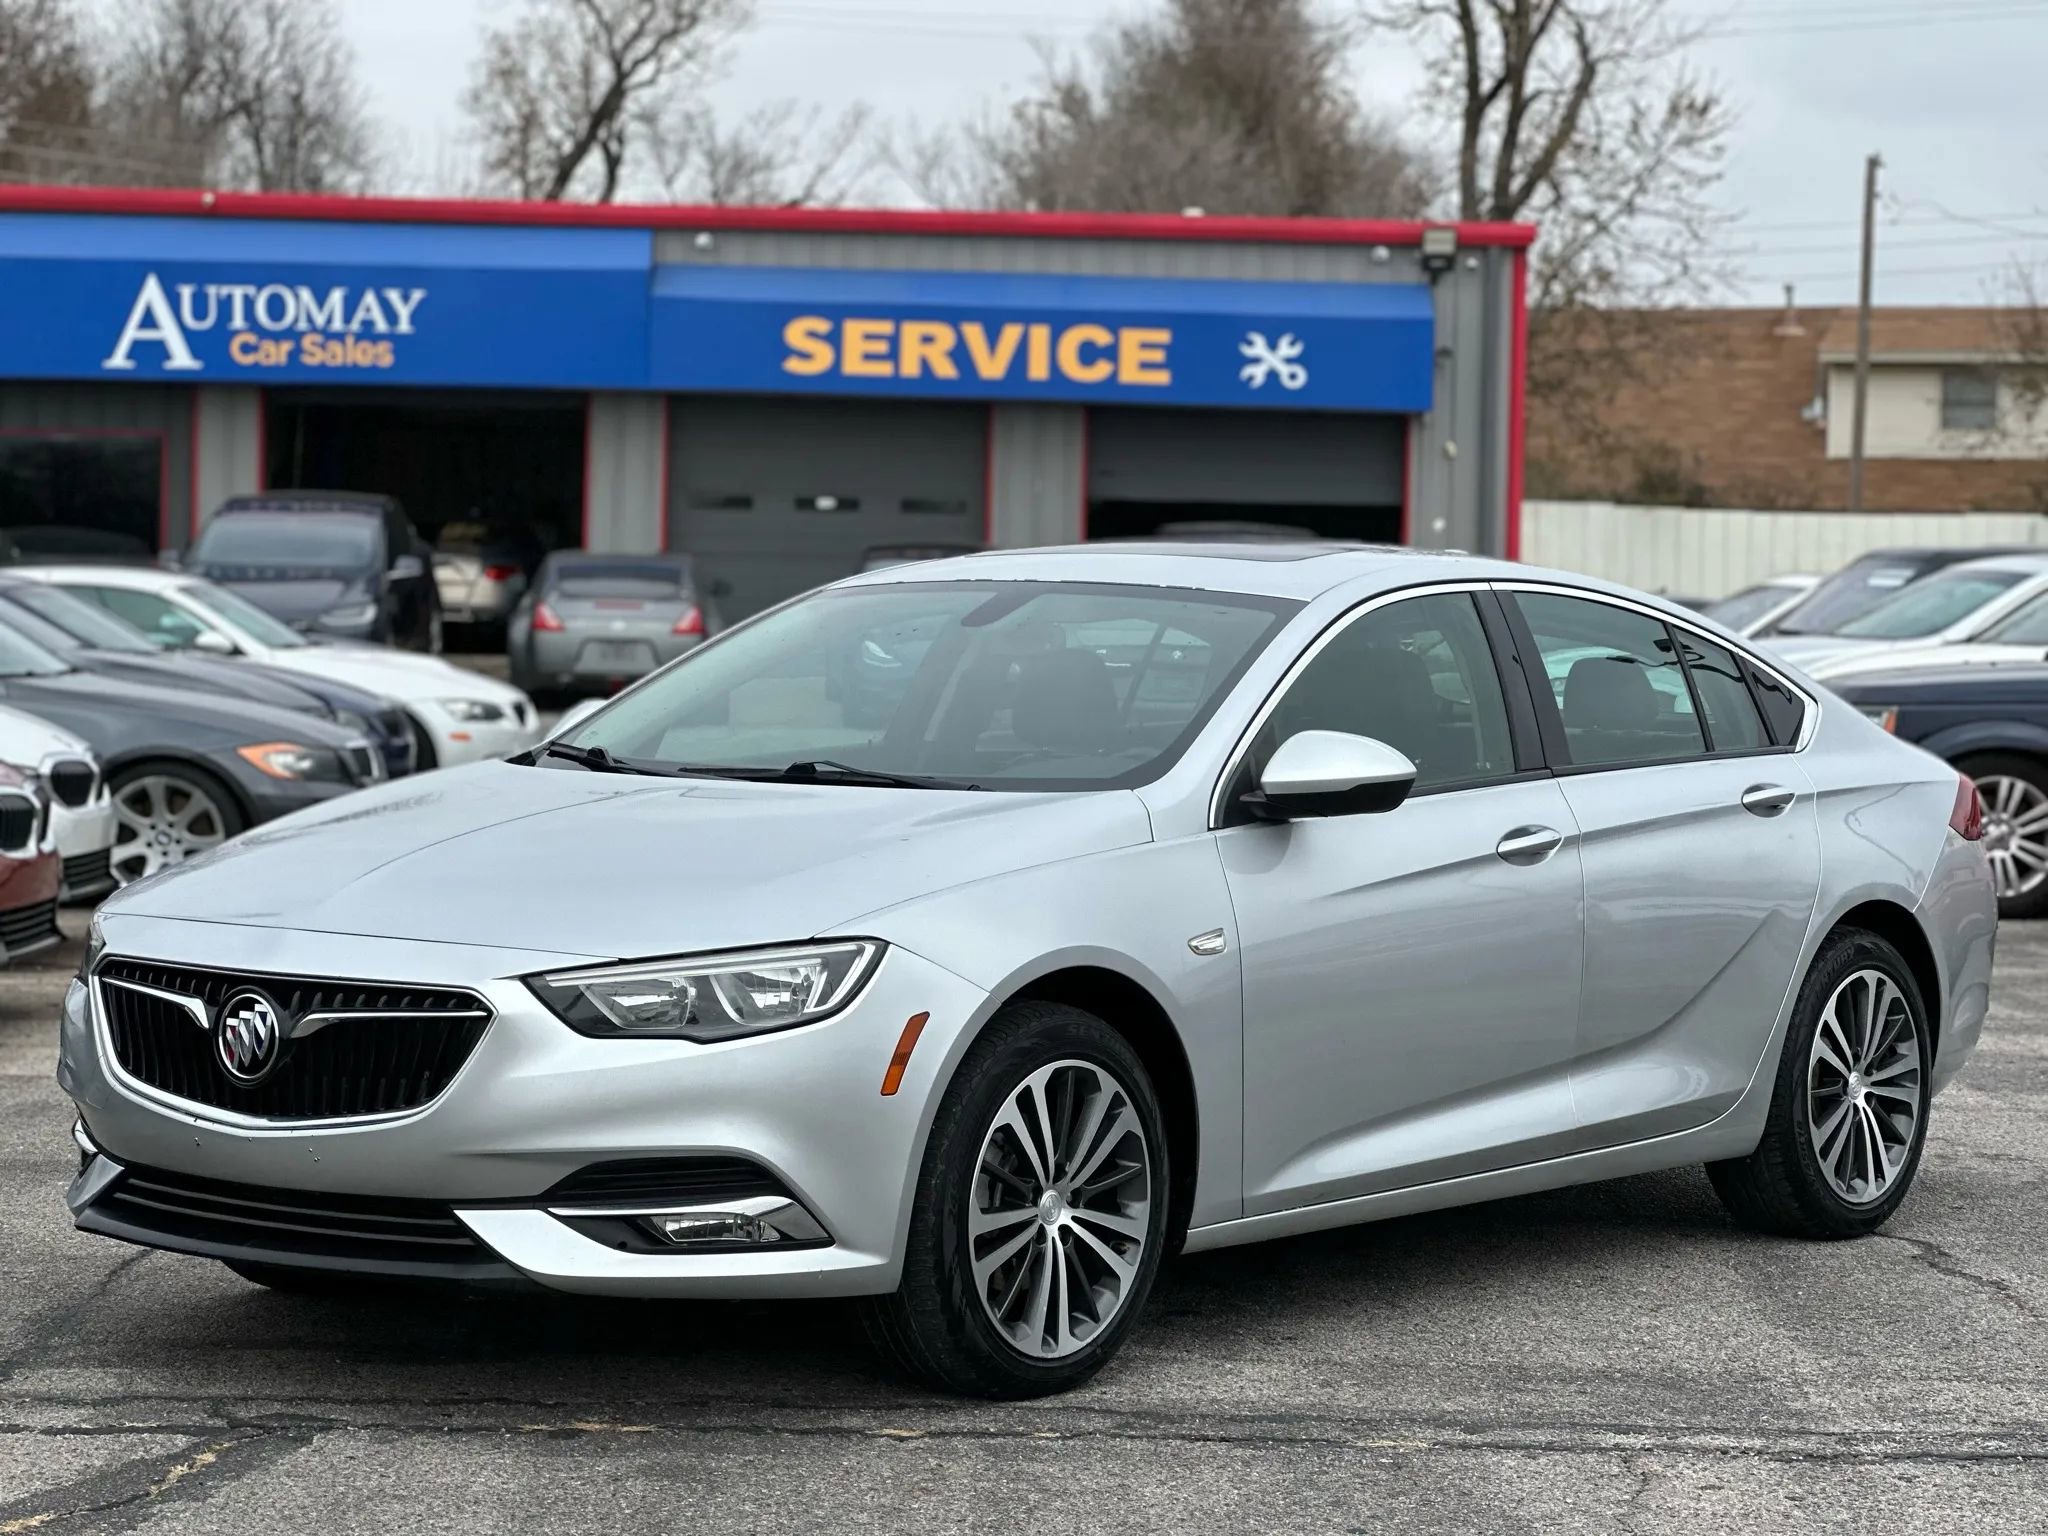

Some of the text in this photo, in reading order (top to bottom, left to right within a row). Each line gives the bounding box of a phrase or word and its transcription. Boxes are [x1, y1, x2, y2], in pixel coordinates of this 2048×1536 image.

[101, 272, 427, 371] AUTOMAY
[229, 331, 395, 368] Car Sales
[781, 315, 1172, 387] SERVICE
